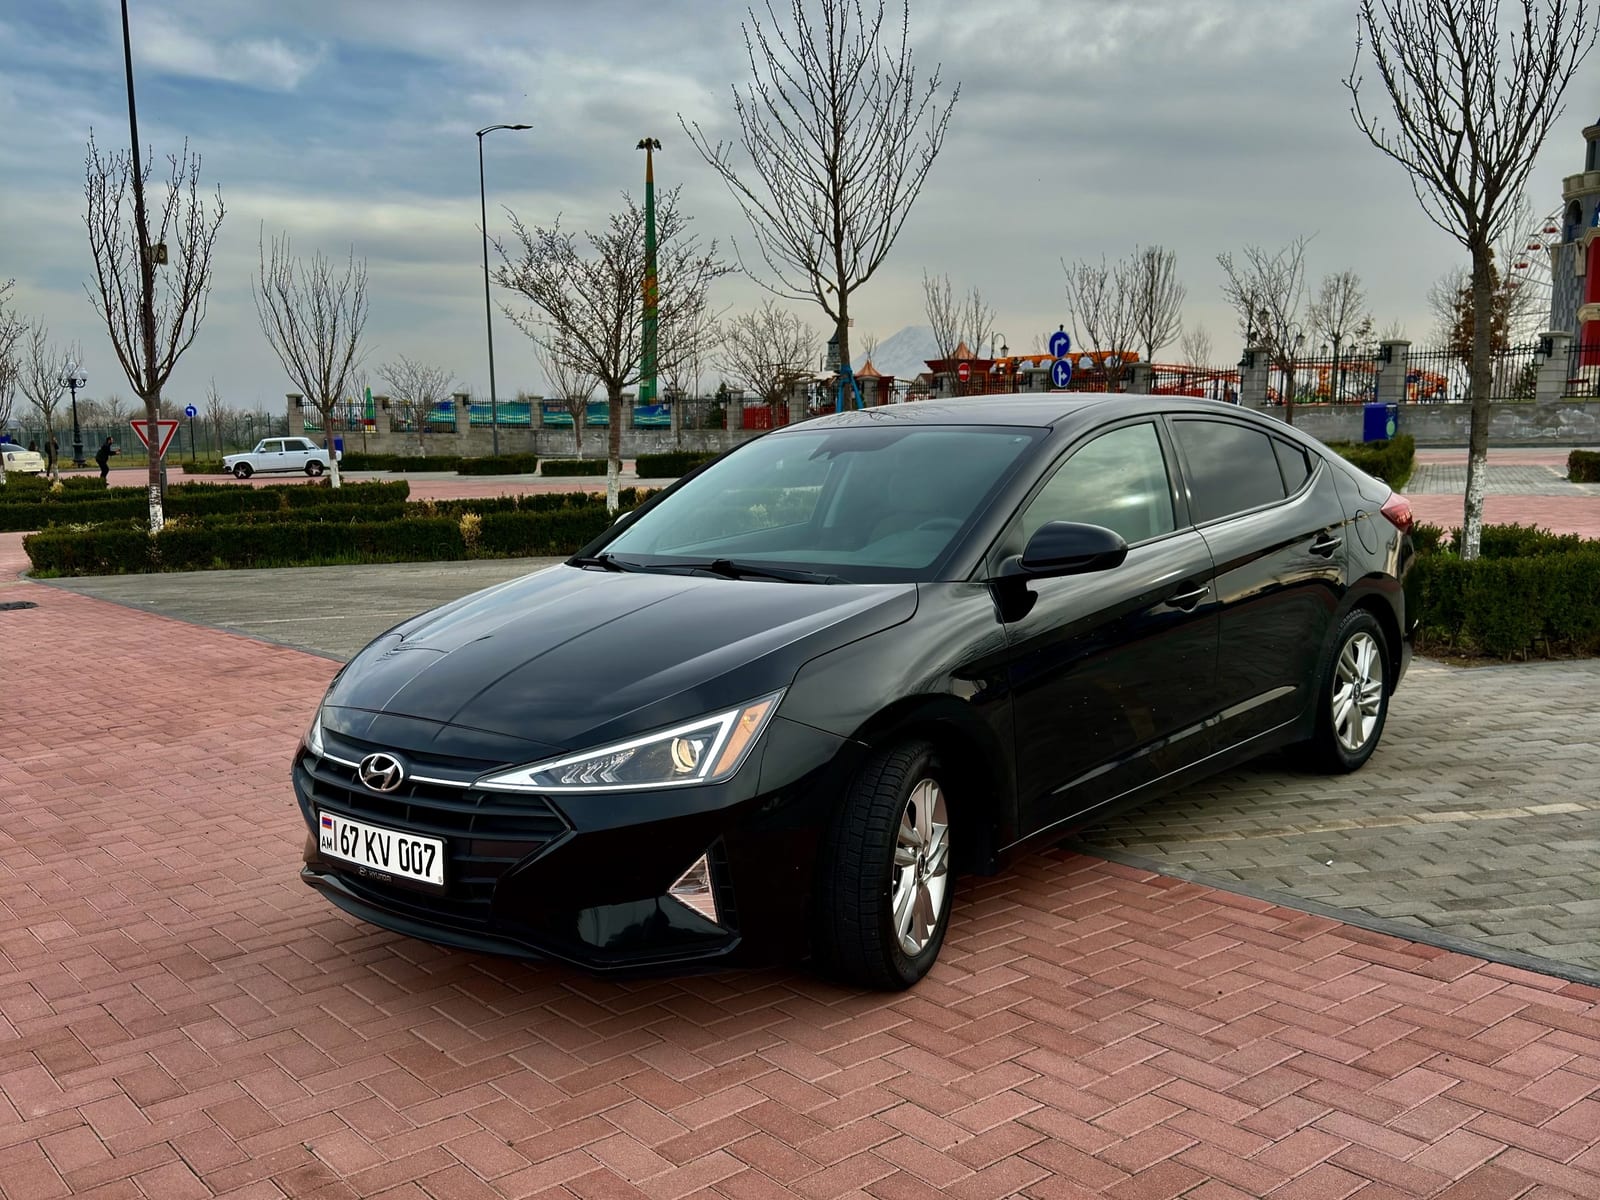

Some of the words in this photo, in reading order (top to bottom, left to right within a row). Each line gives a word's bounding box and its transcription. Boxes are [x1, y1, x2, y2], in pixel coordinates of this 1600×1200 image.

[321, 835, 332, 850] AM
[340, 824, 359, 858] 67
[364, 829, 391, 867] KV
[398, 838, 436, 877] 007
